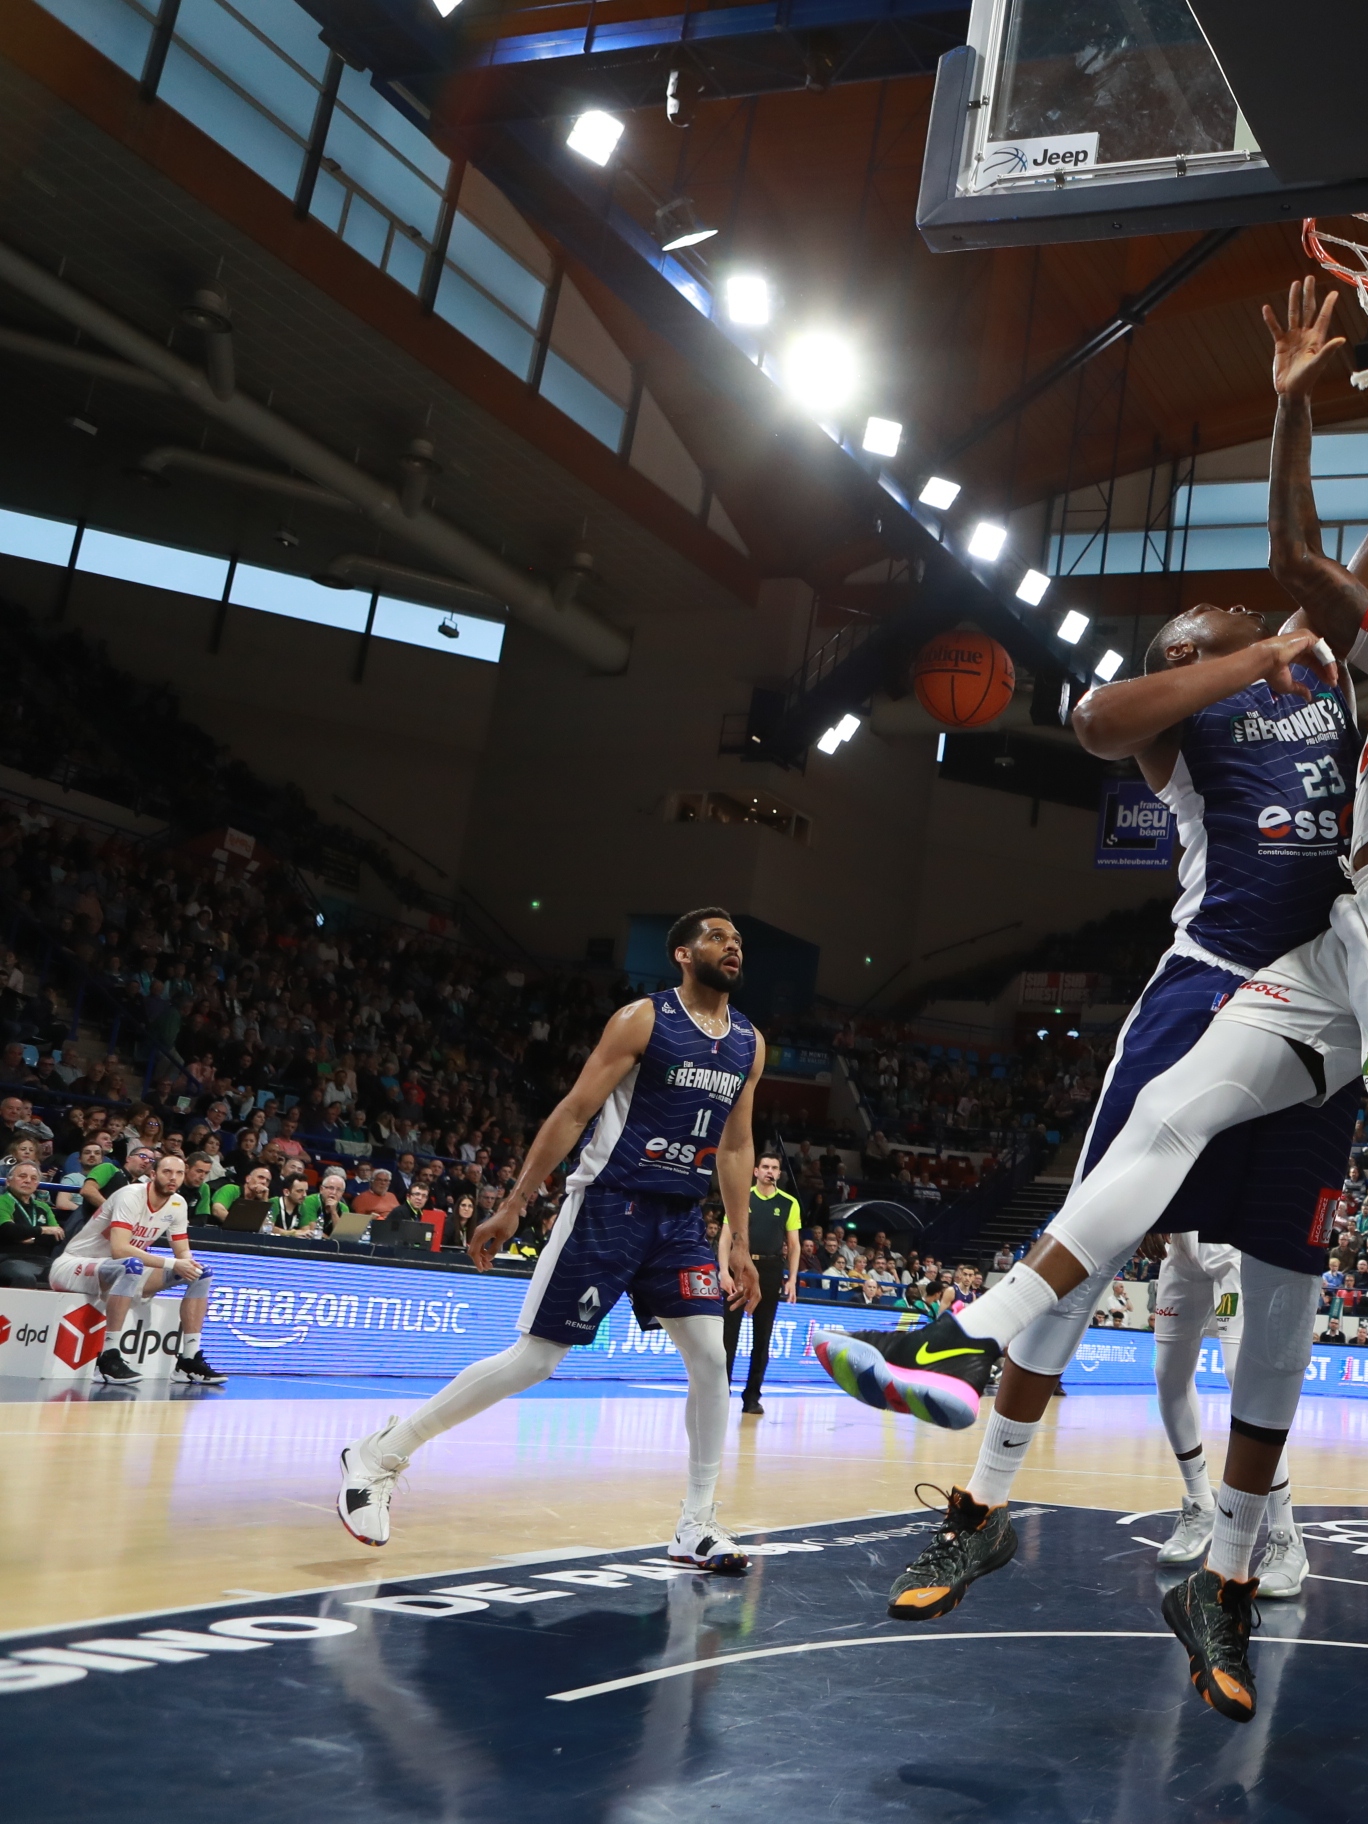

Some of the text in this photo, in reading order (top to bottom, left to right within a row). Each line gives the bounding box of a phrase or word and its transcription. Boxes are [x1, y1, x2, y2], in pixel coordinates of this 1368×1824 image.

[1033, 148, 1089, 167] Jeep
[1295, 755, 1346, 798] 23
[1117, 804, 1168, 828] bleu
[1139, 827, 1166, 837] béarn
[1097, 858, 1169, 866] www.bleubearn.fr
[1258, 849, 1300, 857] Construisons
[683, 1060, 694, 1068] Elan
[675, 1067, 740, 1097] BEARNAIS
[690, 1108, 712, 1138] 11
[207, 1285, 470, 1335] amazon music
[16, 1323, 50, 1347] dpd
[564, 1319, 597, 1331] RENAULT
[119, 1319, 183, 1364] dpd
[342, 1581, 576, 1618] DE
